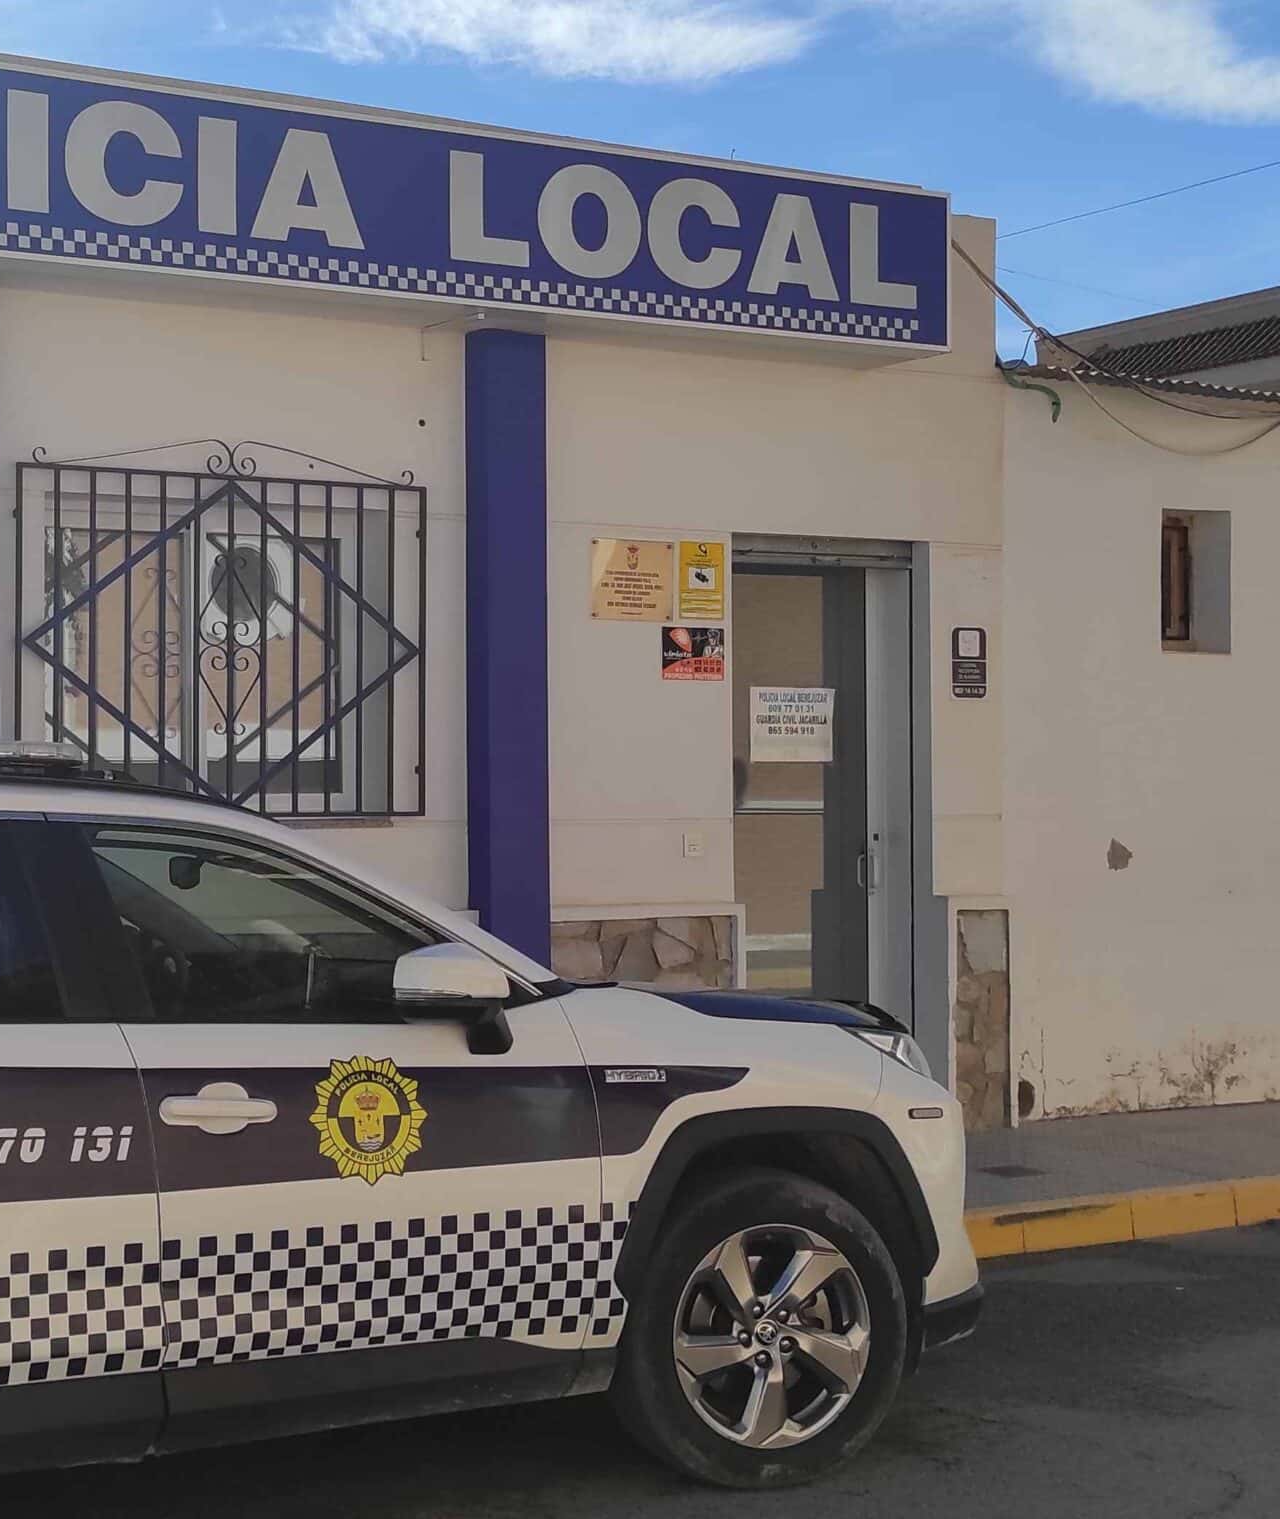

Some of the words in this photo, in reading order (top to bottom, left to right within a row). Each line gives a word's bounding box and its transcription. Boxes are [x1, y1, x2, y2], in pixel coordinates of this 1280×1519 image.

[449, 150, 918, 310] LOCAL
[756, 714, 781, 724] GUARDIA
[782, 714, 797, 724] CIVIL
[783, 704, 793, 712] 77
[334, 1072, 368, 1097] POLICIA
[371, 1073, 400, 1095] LOCAL
[70, 1126, 134, 1162] 131
